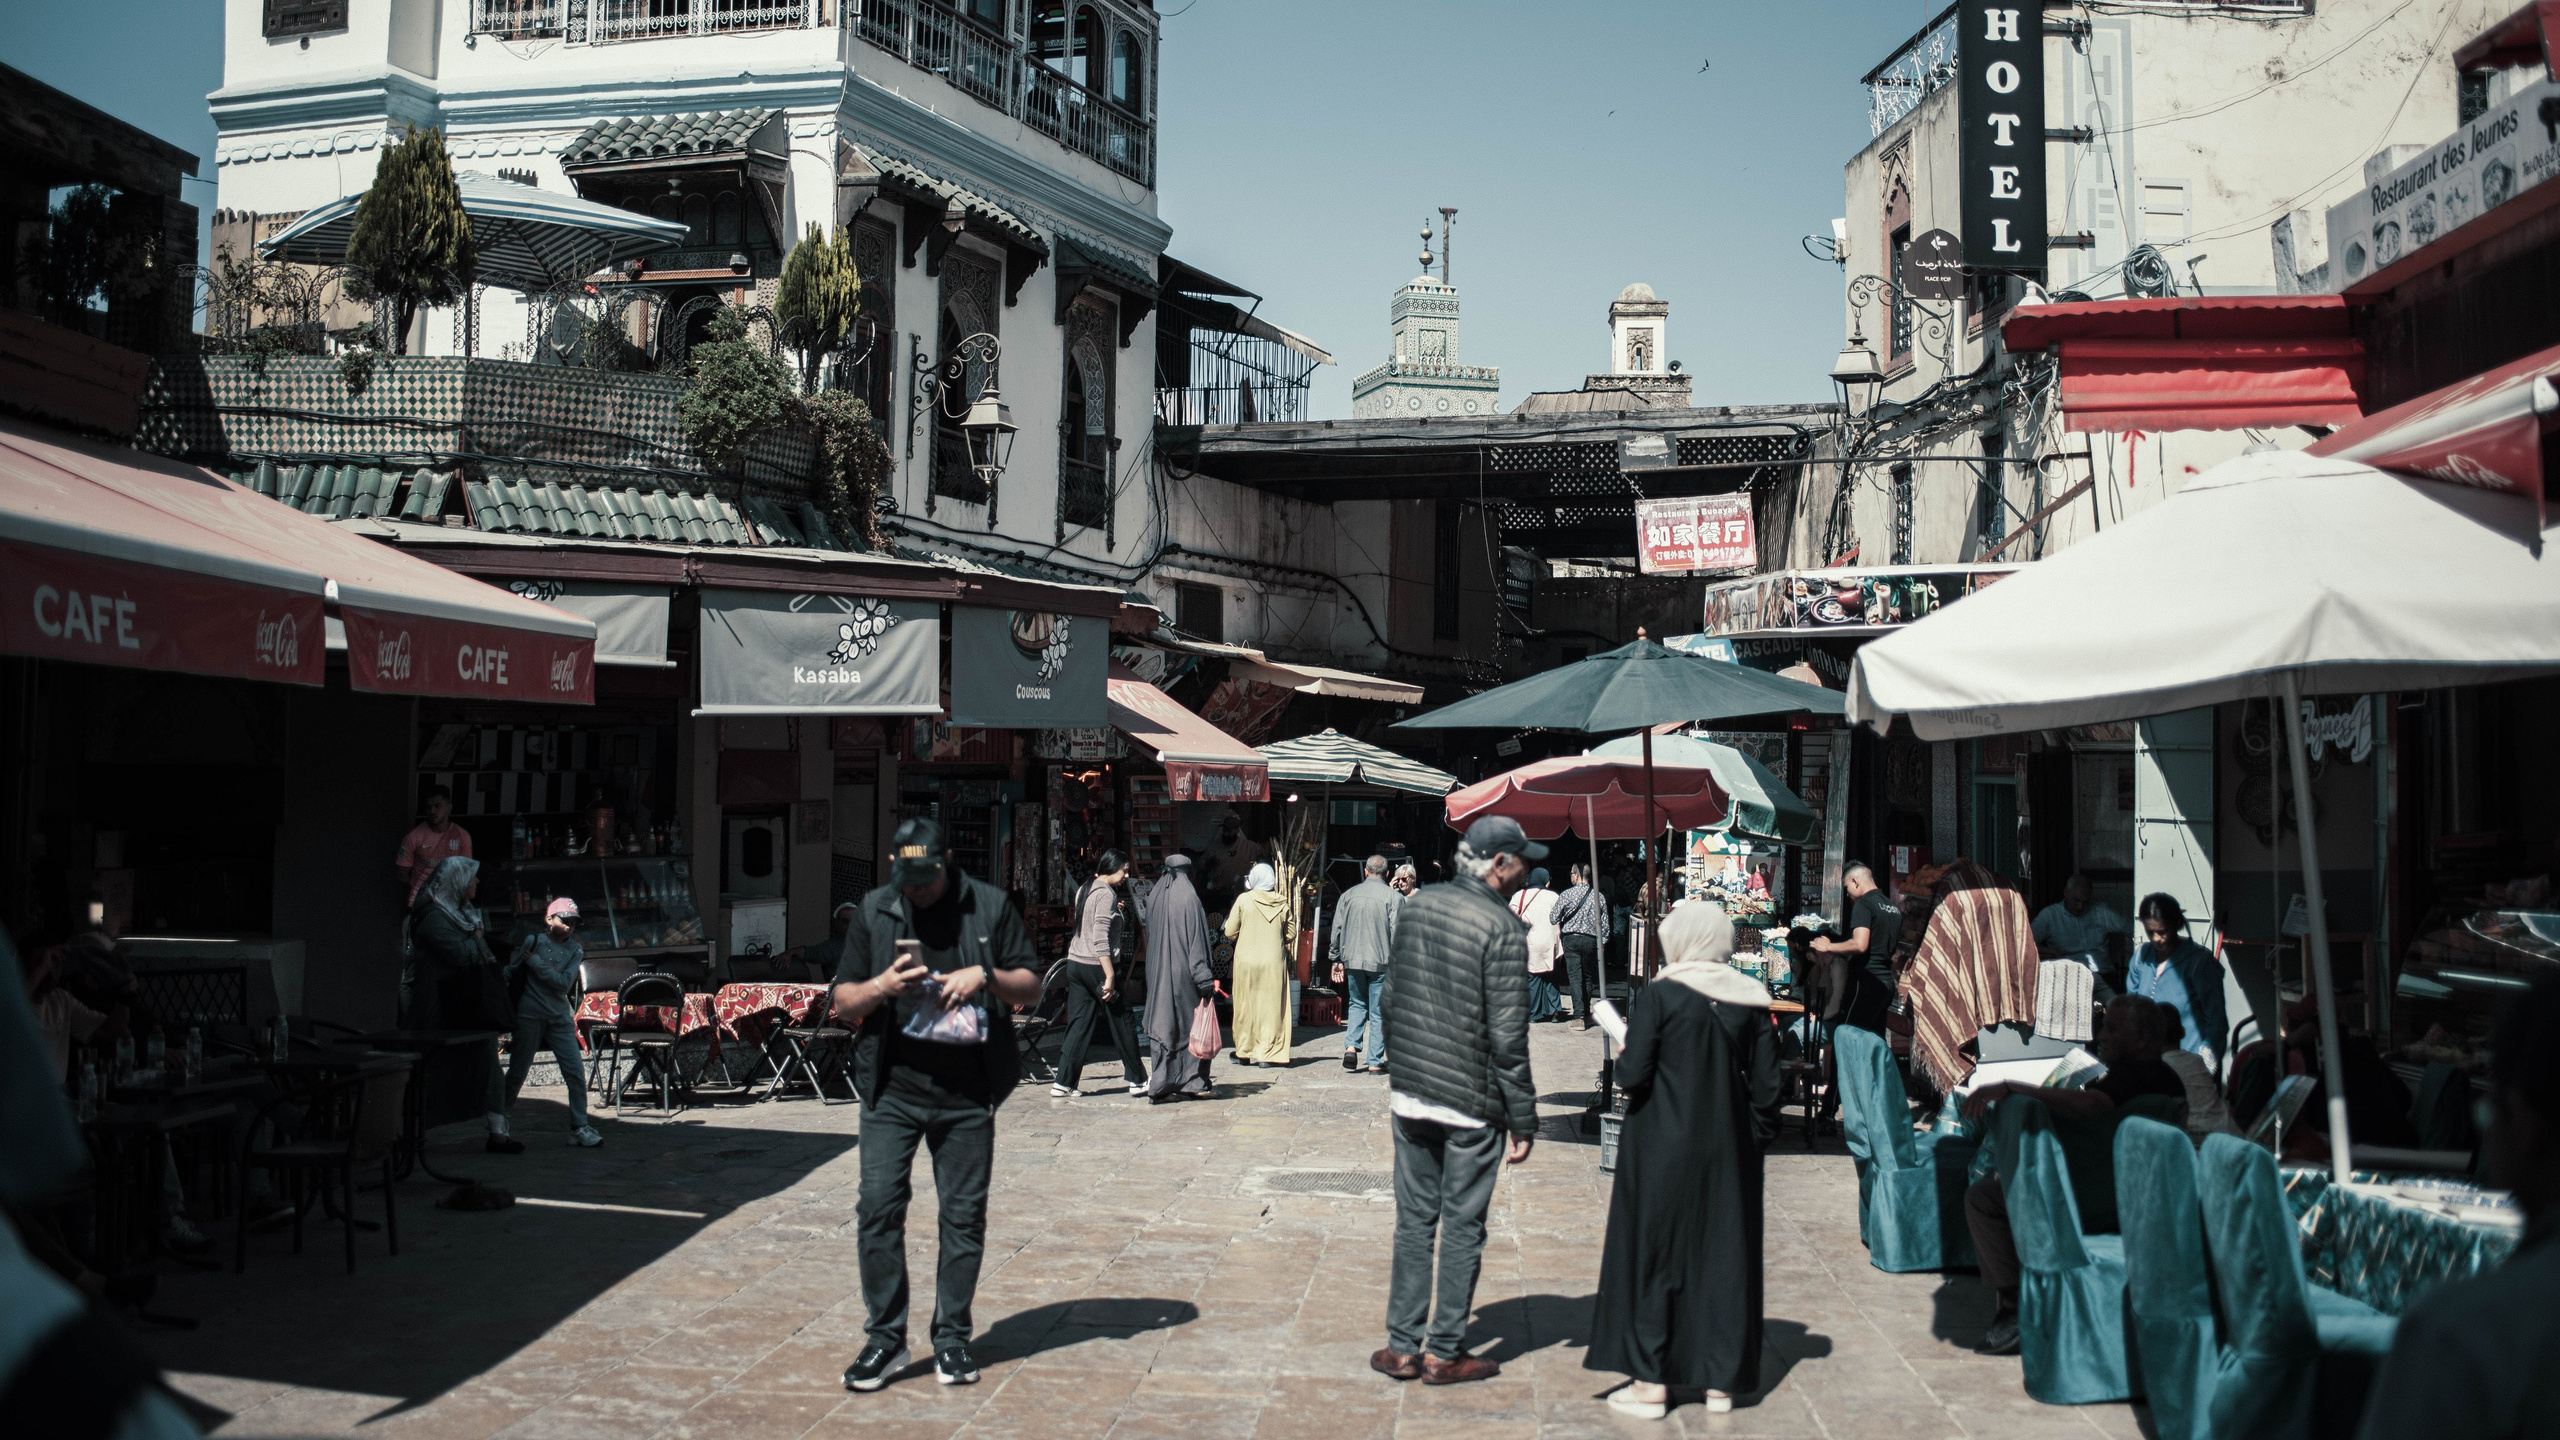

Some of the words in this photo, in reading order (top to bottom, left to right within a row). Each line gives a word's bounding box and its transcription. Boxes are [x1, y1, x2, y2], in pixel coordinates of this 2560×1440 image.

[1983, 8, 2022, 253] HOTEL
[2371, 154, 2438, 216] Restaurant
[2441, 142, 2465, 175] des
[2469, 110, 2518, 161] Jeunes
[1652, 508, 1700, 519] Restaurant
[1647, 520, 1746, 548] 如家餐厅
[1683, 644, 1731, 661] OTEL
[1733, 638, 1800, 659] CASCADE
[793, 666, 861, 684] Kasaba
[1016, 683, 1051, 700] Couscous
